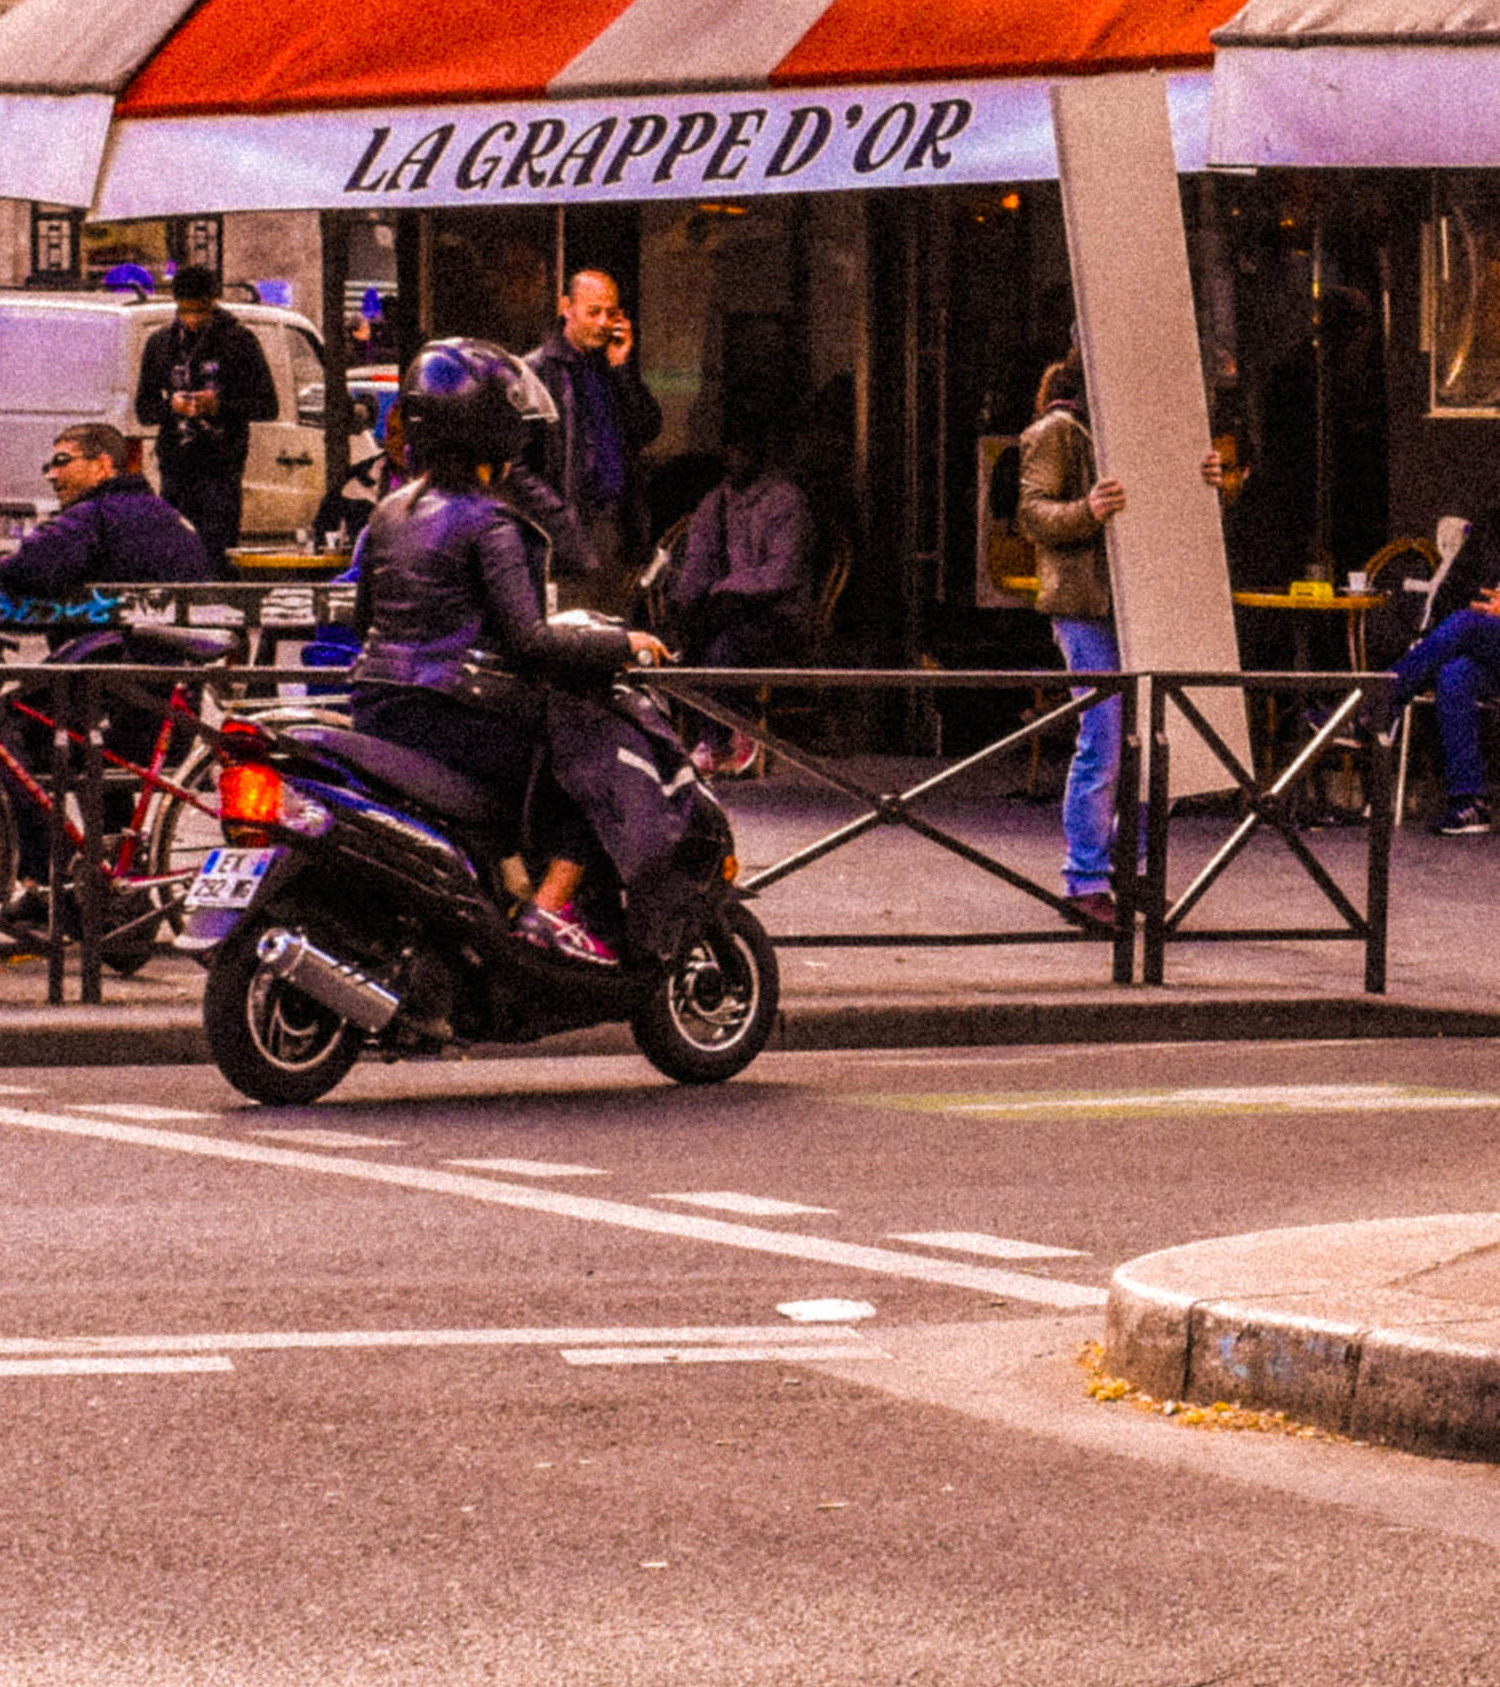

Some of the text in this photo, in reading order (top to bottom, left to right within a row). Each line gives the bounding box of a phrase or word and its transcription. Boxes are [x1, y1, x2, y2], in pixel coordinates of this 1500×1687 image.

[344, 98, 973, 194] LA GRAPPE D'OR
